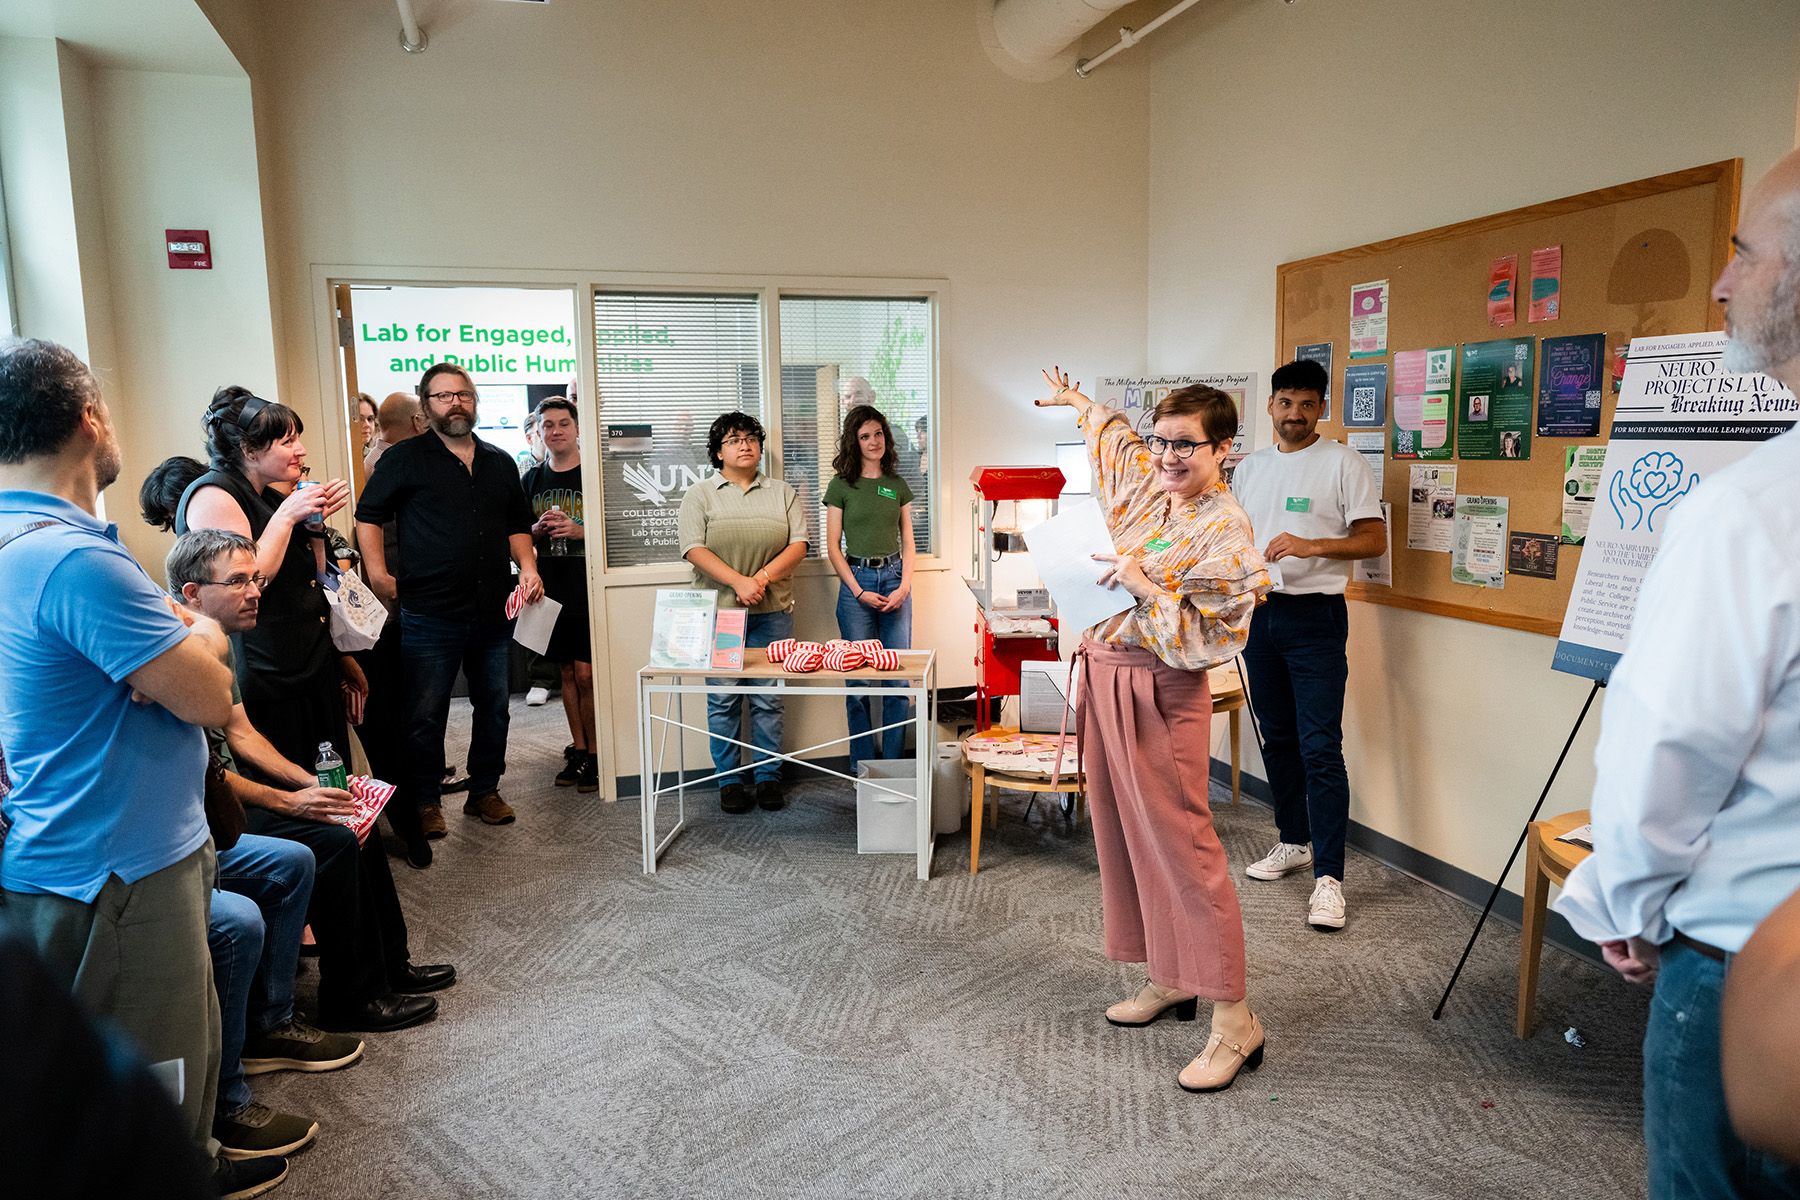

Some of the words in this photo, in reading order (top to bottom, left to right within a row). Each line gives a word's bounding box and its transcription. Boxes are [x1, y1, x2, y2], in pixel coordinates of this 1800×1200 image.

[362, 323, 408, 342] Lab
[416, 323, 451, 342] for
[459, 325, 572, 347] Engaged,
[1645, 344, 1656, 352] FOR
[1657, 342, 1687, 351] ENGAGED,
[1688, 341, 1714, 349] APPLIED,
[390, 354, 434, 372] and
[1104, 378, 1115, 386] The
[1116, 378, 1136, 389] Milpa
[1137, 377, 1180, 389] Agricultural
[1181, 376, 1225, 387] Placemaking
[1226, 375, 1249, 386] Project
[1551, 371, 1591, 390] Change
[1645, 377, 1716, 395] PROJECT
[1717, 377, 1735, 393] IS
[1670, 394, 1744, 416] Breaking
[1748, 393, 1799, 413] News
[622, 509, 666, 518] COLLEGE
[641, 519, 648, 527] &
[649, 518, 679, 526] SOCIA
[631, 528, 649, 537] Lab
[650, 528, 663, 536] for
[644, 538, 651, 546] &
[652, 538, 679, 546] Public
[1631, 552, 1656, 562] VARIET
[1626, 559, 1652, 569] PERCE
[1587, 569, 1620, 580] Researchers
[1622, 574, 1637, 583] from
[1584, 579, 1604, 588] Liberal
[1606, 582, 1618, 590] Arts
[1580, 596, 1597, 605] Public
[1597, 600, 1619, 609] Service
[1609, 592, 1631, 602] College
[1577, 606, 1595, 614] create
[1602, 611, 1624, 620] archive
[1574, 615, 1606, 626] perception,
